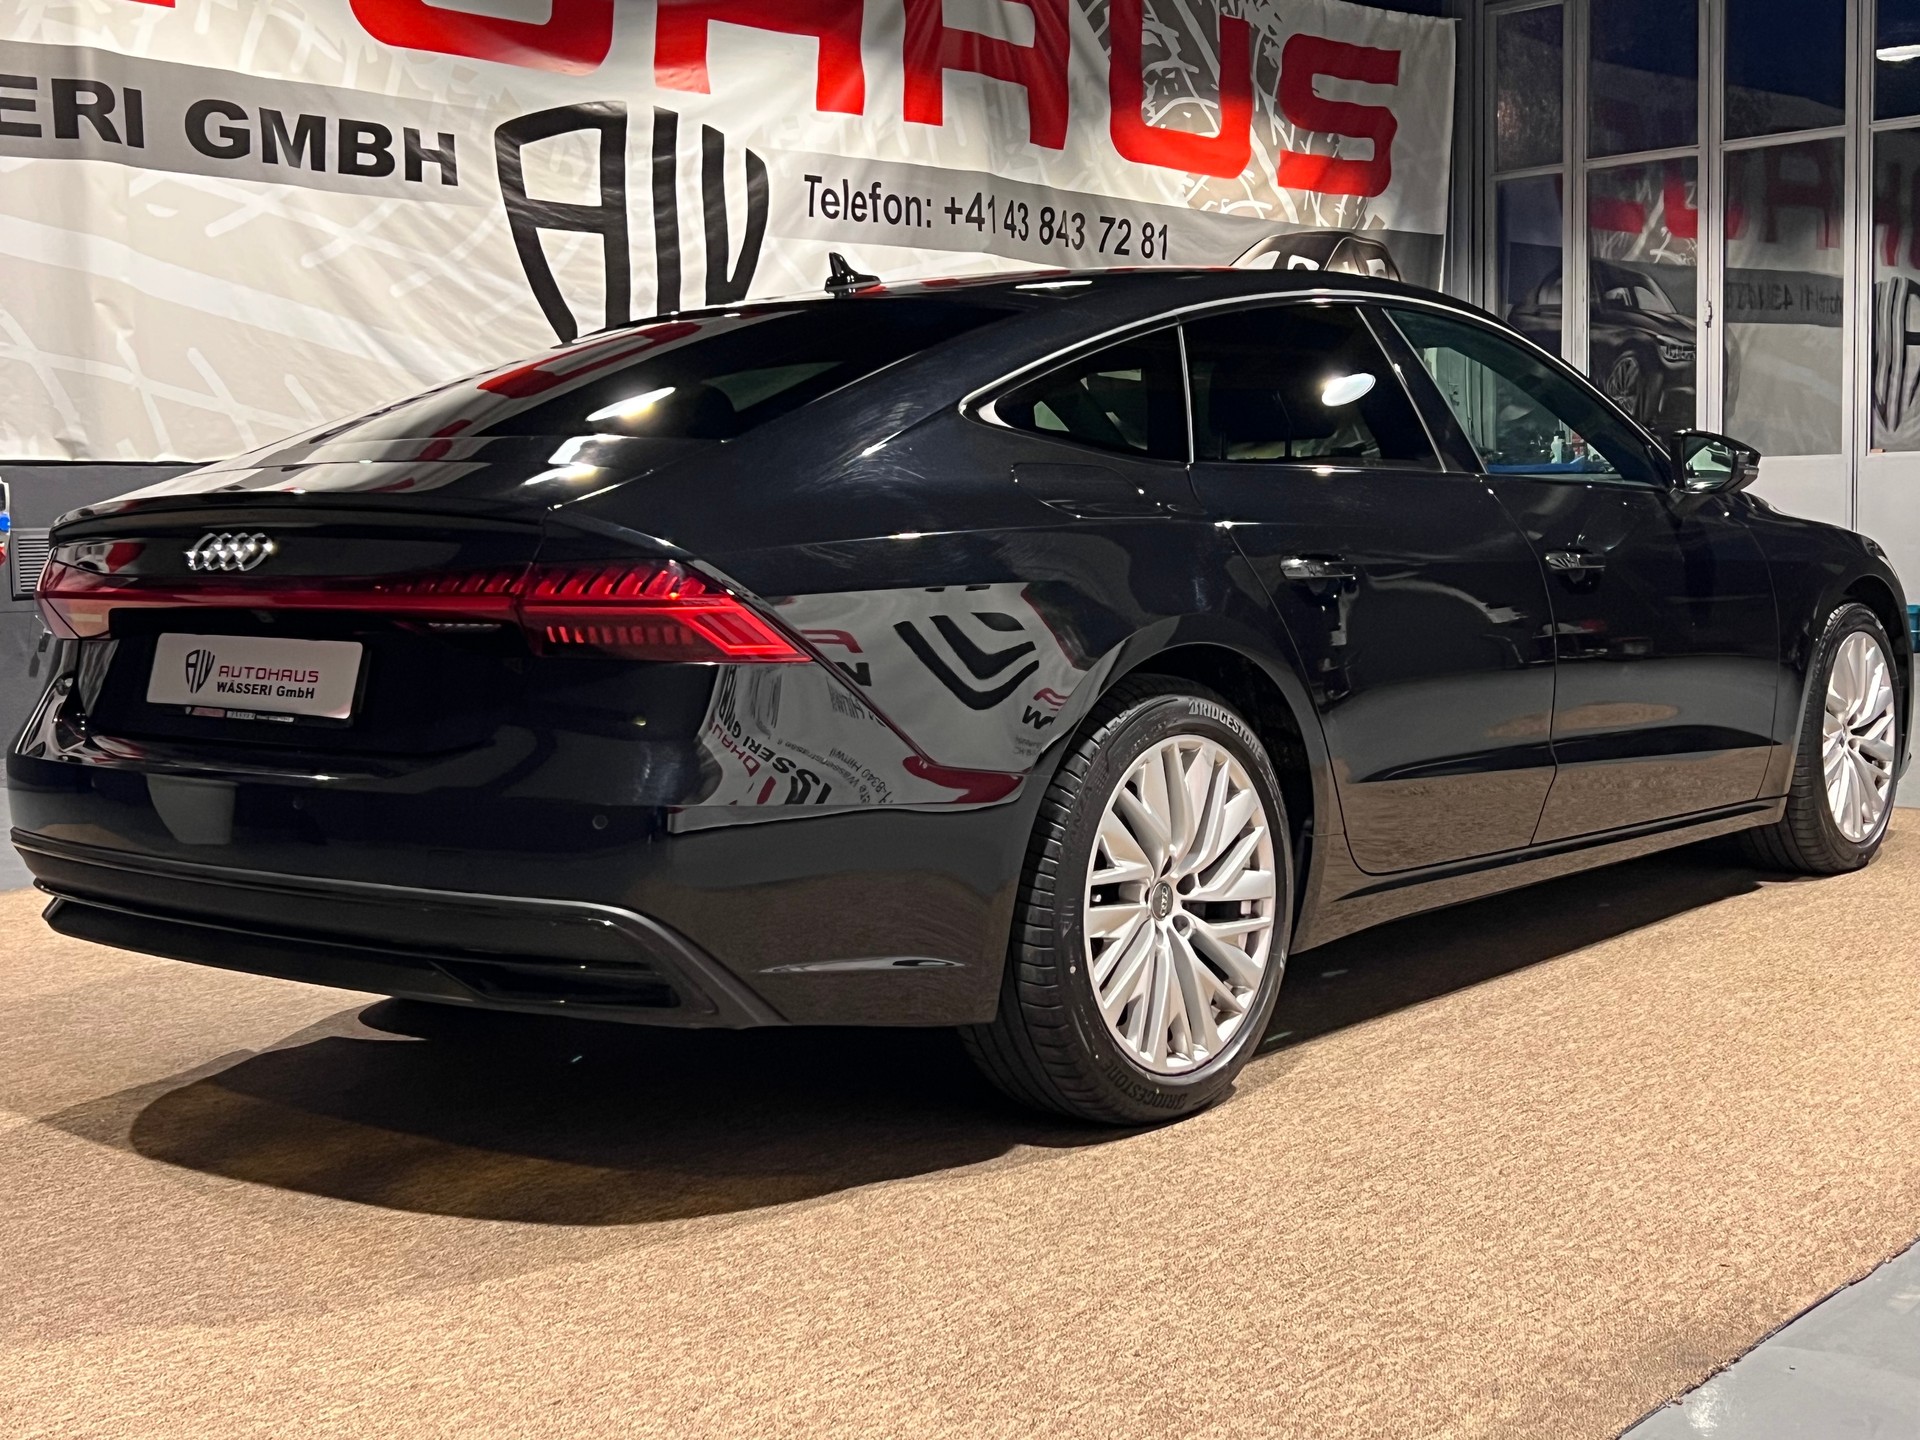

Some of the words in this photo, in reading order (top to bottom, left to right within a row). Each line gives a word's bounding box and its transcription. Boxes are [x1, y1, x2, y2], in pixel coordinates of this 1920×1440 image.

[185, 99, 458, 186] GMBH
[804, 174, 931, 228] Telefon:
[944, 192, 996, 234] +41
[1004, 200, 1028, 241] 43
[1039, 206, 1085, 250] 843
[1098, 216, 1131, 256] 72
[1141, 222, 1168, 260] 81
[218, 665, 319, 683] AUTOHAUS
[276, 686, 315, 699] GmbH
[1188, 699, 1264, 761] BRIDGESTONE
